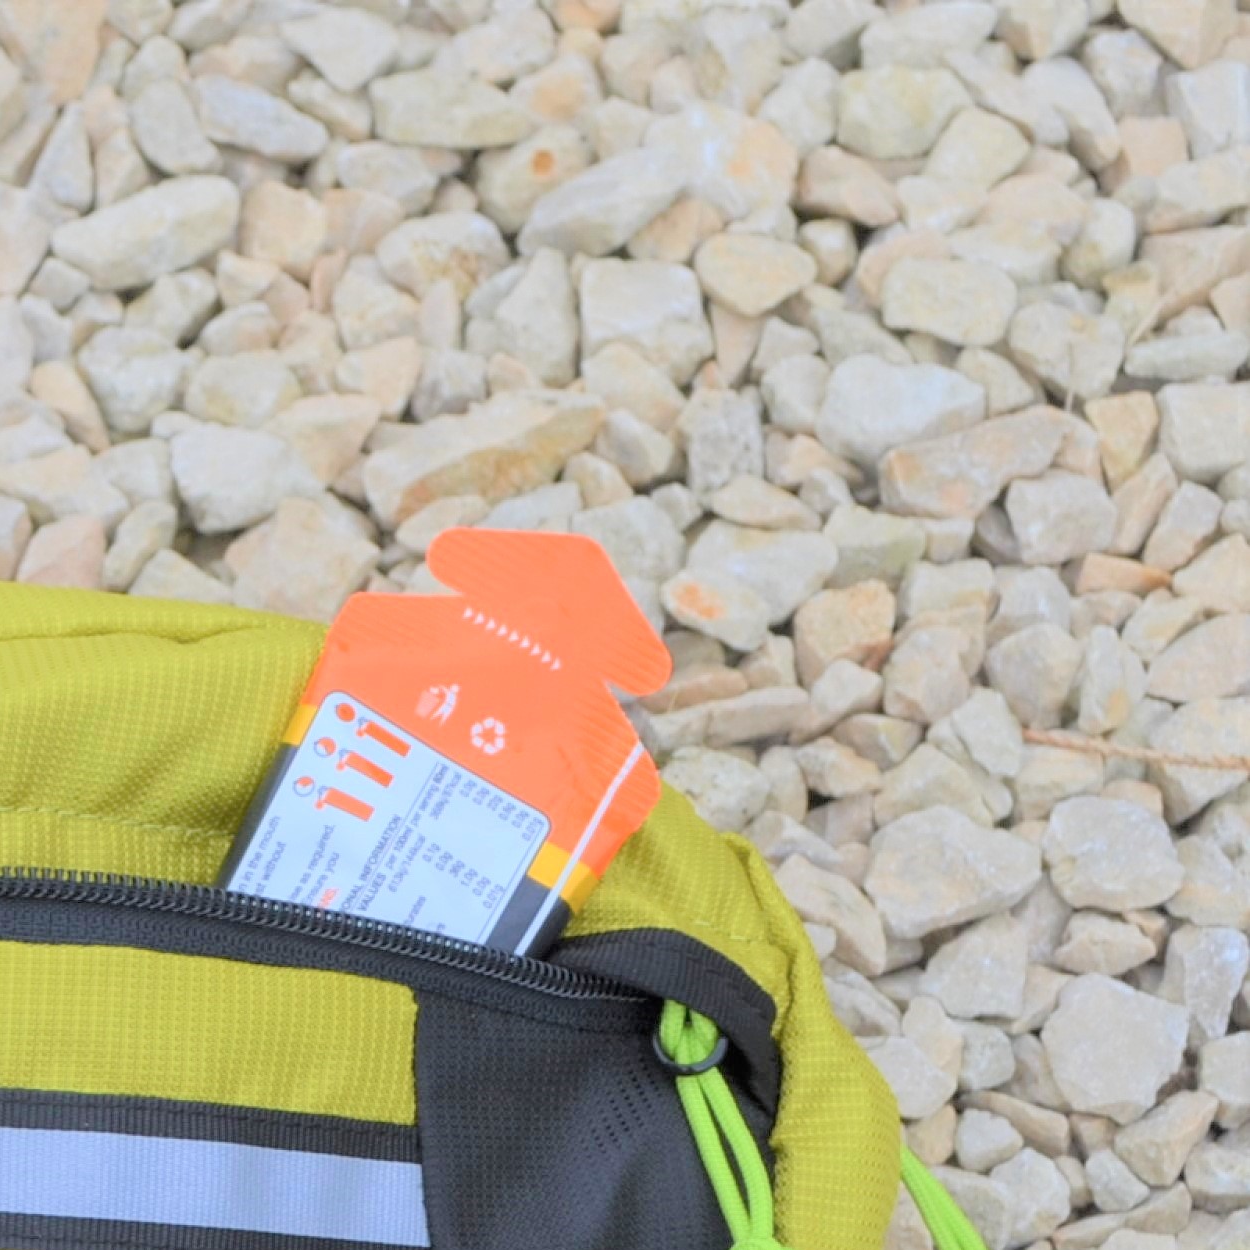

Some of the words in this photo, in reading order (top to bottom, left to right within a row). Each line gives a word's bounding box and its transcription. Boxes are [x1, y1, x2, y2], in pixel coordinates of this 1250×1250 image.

[248, 852, 262, 869] the
[260, 816, 280, 849] mouth
[263, 842, 286, 880] without
[325, 852, 339, 873] you
[357, 873, 386, 911] VALUES
[385, 853, 398, 871] per
[411, 811, 422, 827] per
[419, 785, 439, 811] serving
[359, 816, 400, 881] INFORMATION
